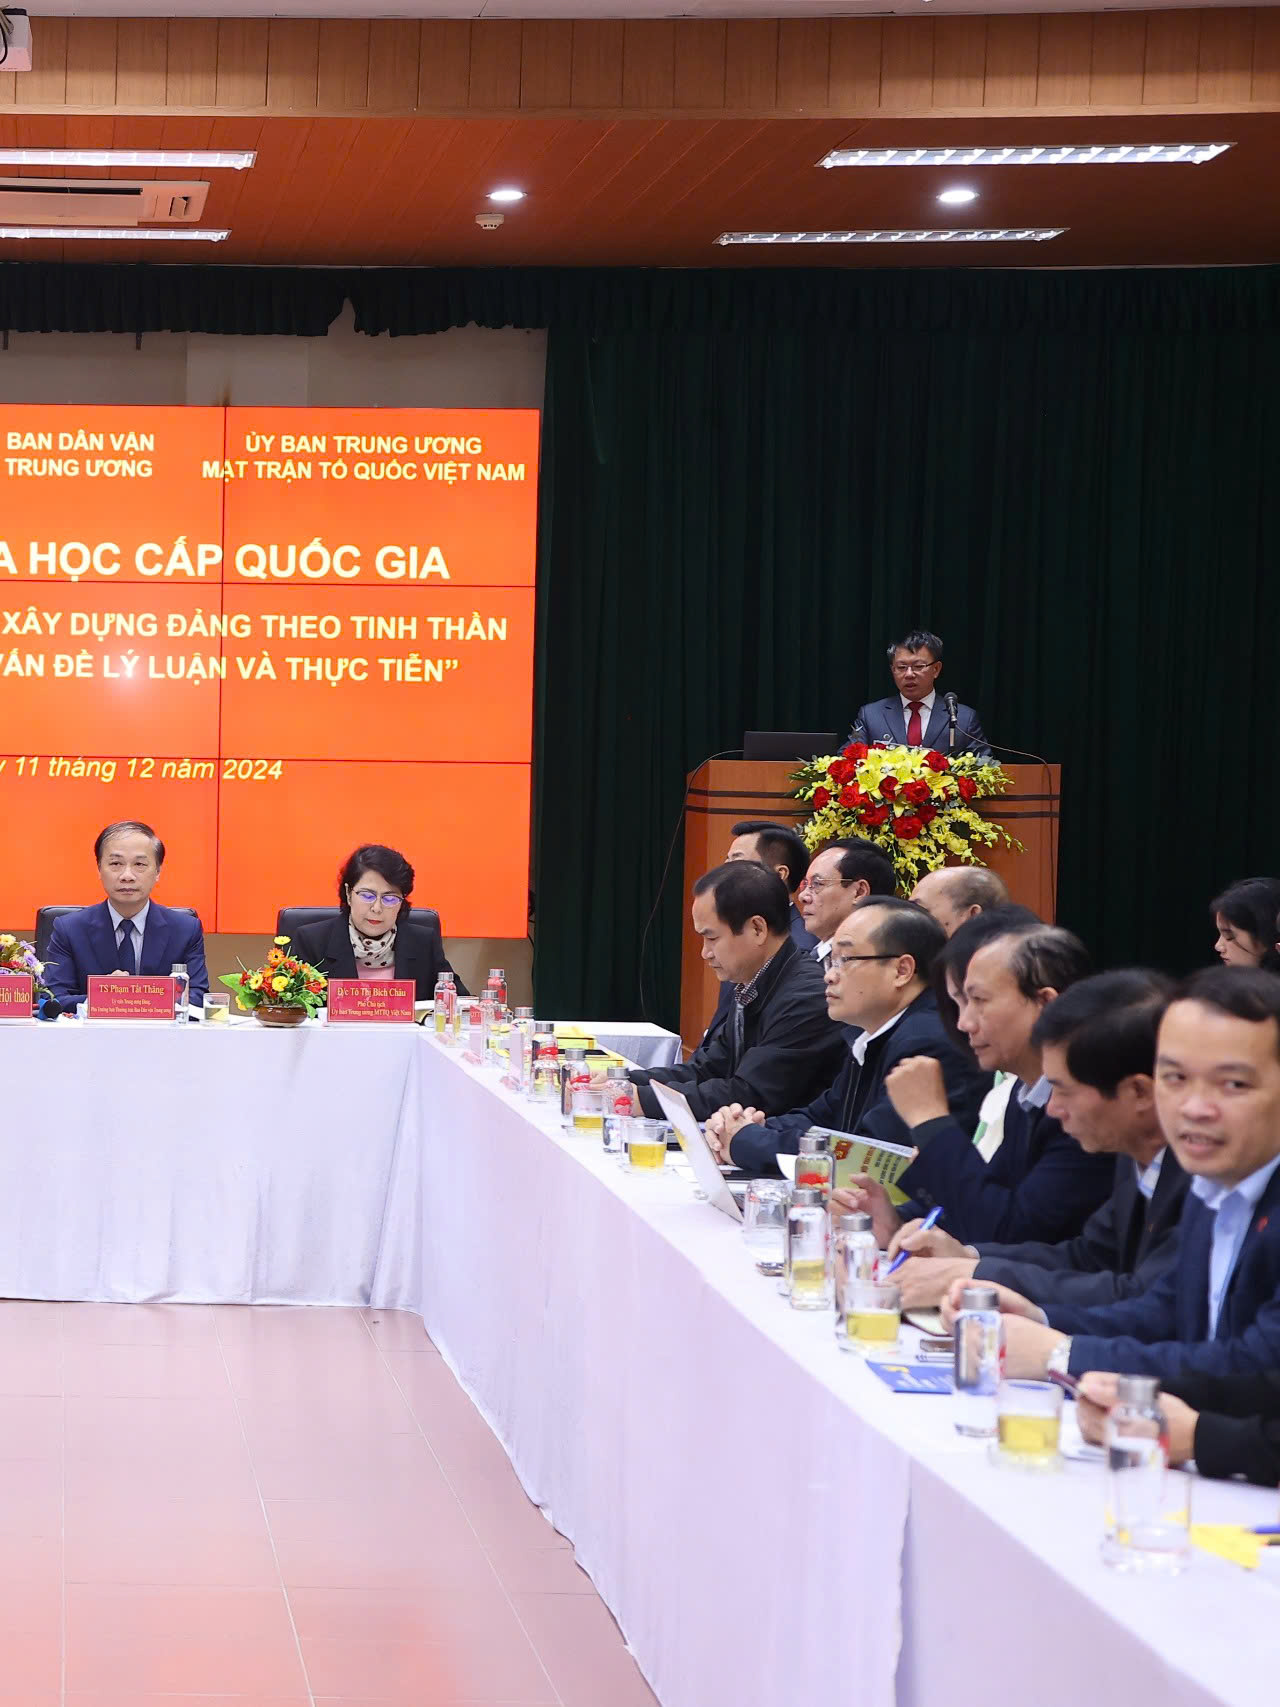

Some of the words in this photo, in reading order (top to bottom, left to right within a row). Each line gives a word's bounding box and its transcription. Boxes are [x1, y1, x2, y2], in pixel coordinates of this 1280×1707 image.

[7, 431, 53, 451] BAN
[58, 428, 104, 451] DÂN
[109, 431, 155, 456] VẬN
[245, 431, 275, 453] ỦY
[281, 435, 327, 453] BAN
[332, 435, 408, 454] TRUNG
[414, 436, 482, 455] ƯƠNG
[4, 457, 80, 477] TRUNG
[85, 458, 153, 478] ƯƠNG
[253, 459, 312, 483] TRẬN
[353, 458, 417, 481] QUỐC
[422, 460, 472, 485] VIỆT
[476, 463, 525, 481] NAM
[28, 541, 121, 582] HỌC
[134, 535, 223, 577] CẤP
[234, 537, 361, 580] QUỐC
[375, 545, 451, 580] GIA
[1, 605, 63, 636] XÂY
[69, 612, 158, 643] DỰNG
[165, 607, 252, 638] ĐẢNG
[260, 614, 342, 639] THEO
[349, 615, 417, 640] TINH
[426, 611, 507, 641] THẦN
[52, 648, 95, 678] ĐỀ
[101, 648, 140, 679] LÝ
[148, 652, 227, 686] LUẬN
[235, 650, 277, 681] VÀ
[285, 657, 369, 688] THỰC
[15, 756, 39, 777] 11
[48, 756, 117, 783] tháng
[127, 757, 155, 778] 12
[161, 758, 215, 779] năm
[222, 759, 283, 780] 2024
[13, 988, 30, 1003] thảo
[99, 984, 108, 993] TS
[110, 984, 129, 994] Phạm
[351, 988, 359, 996] Tô
[373, 988, 387, 996] Bích
[389, 988, 406, 996] Châu
